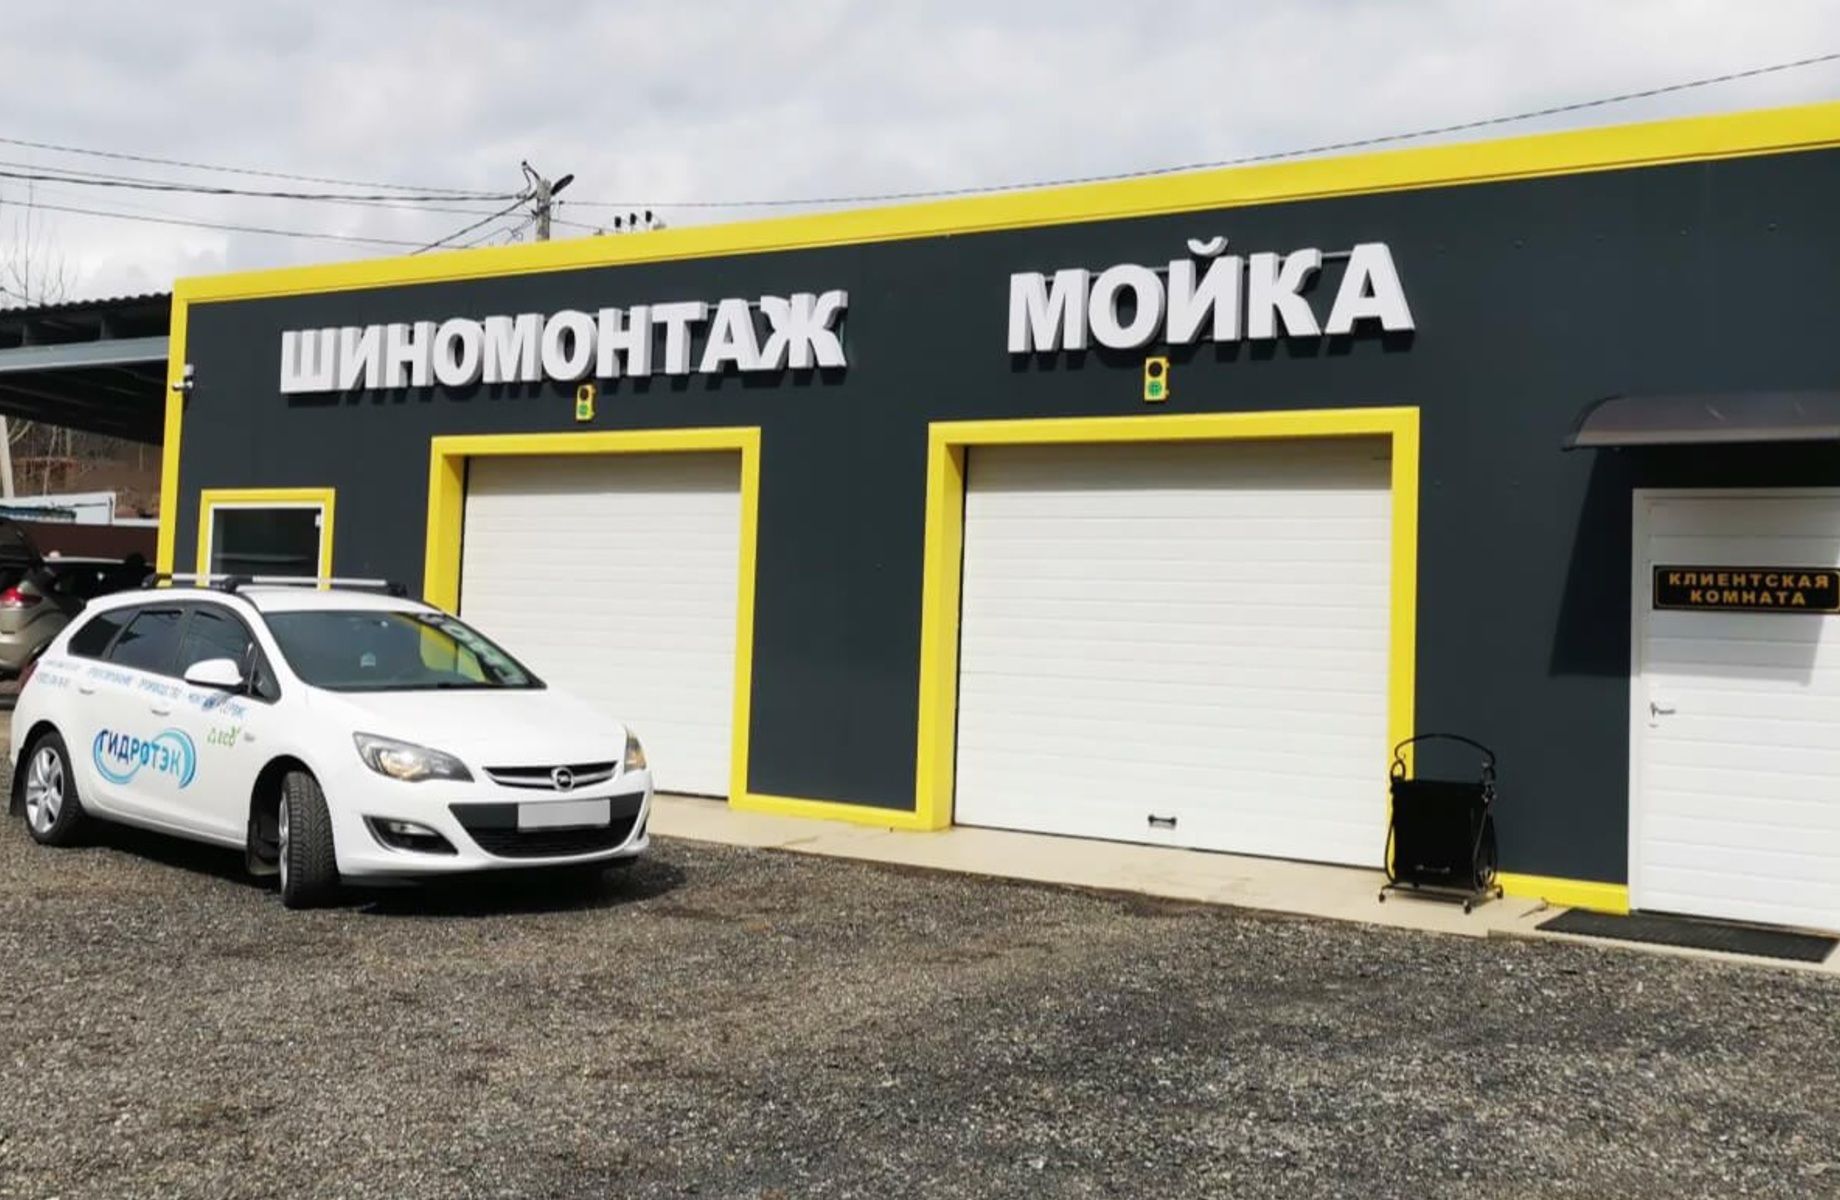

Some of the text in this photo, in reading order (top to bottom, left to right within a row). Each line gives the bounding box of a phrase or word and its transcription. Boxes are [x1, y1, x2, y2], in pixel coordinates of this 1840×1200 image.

[1008, 237, 1416, 354] МОЙКА
[280, 290, 848, 393] ШИНОМОНТАЖ
[1669, 572, 1829, 588] КЛИЕНТСКАЯ
[1690, 590, 1806, 605] КОМНАТА
[99, 729, 181, 776] ГИДРОТЭК
